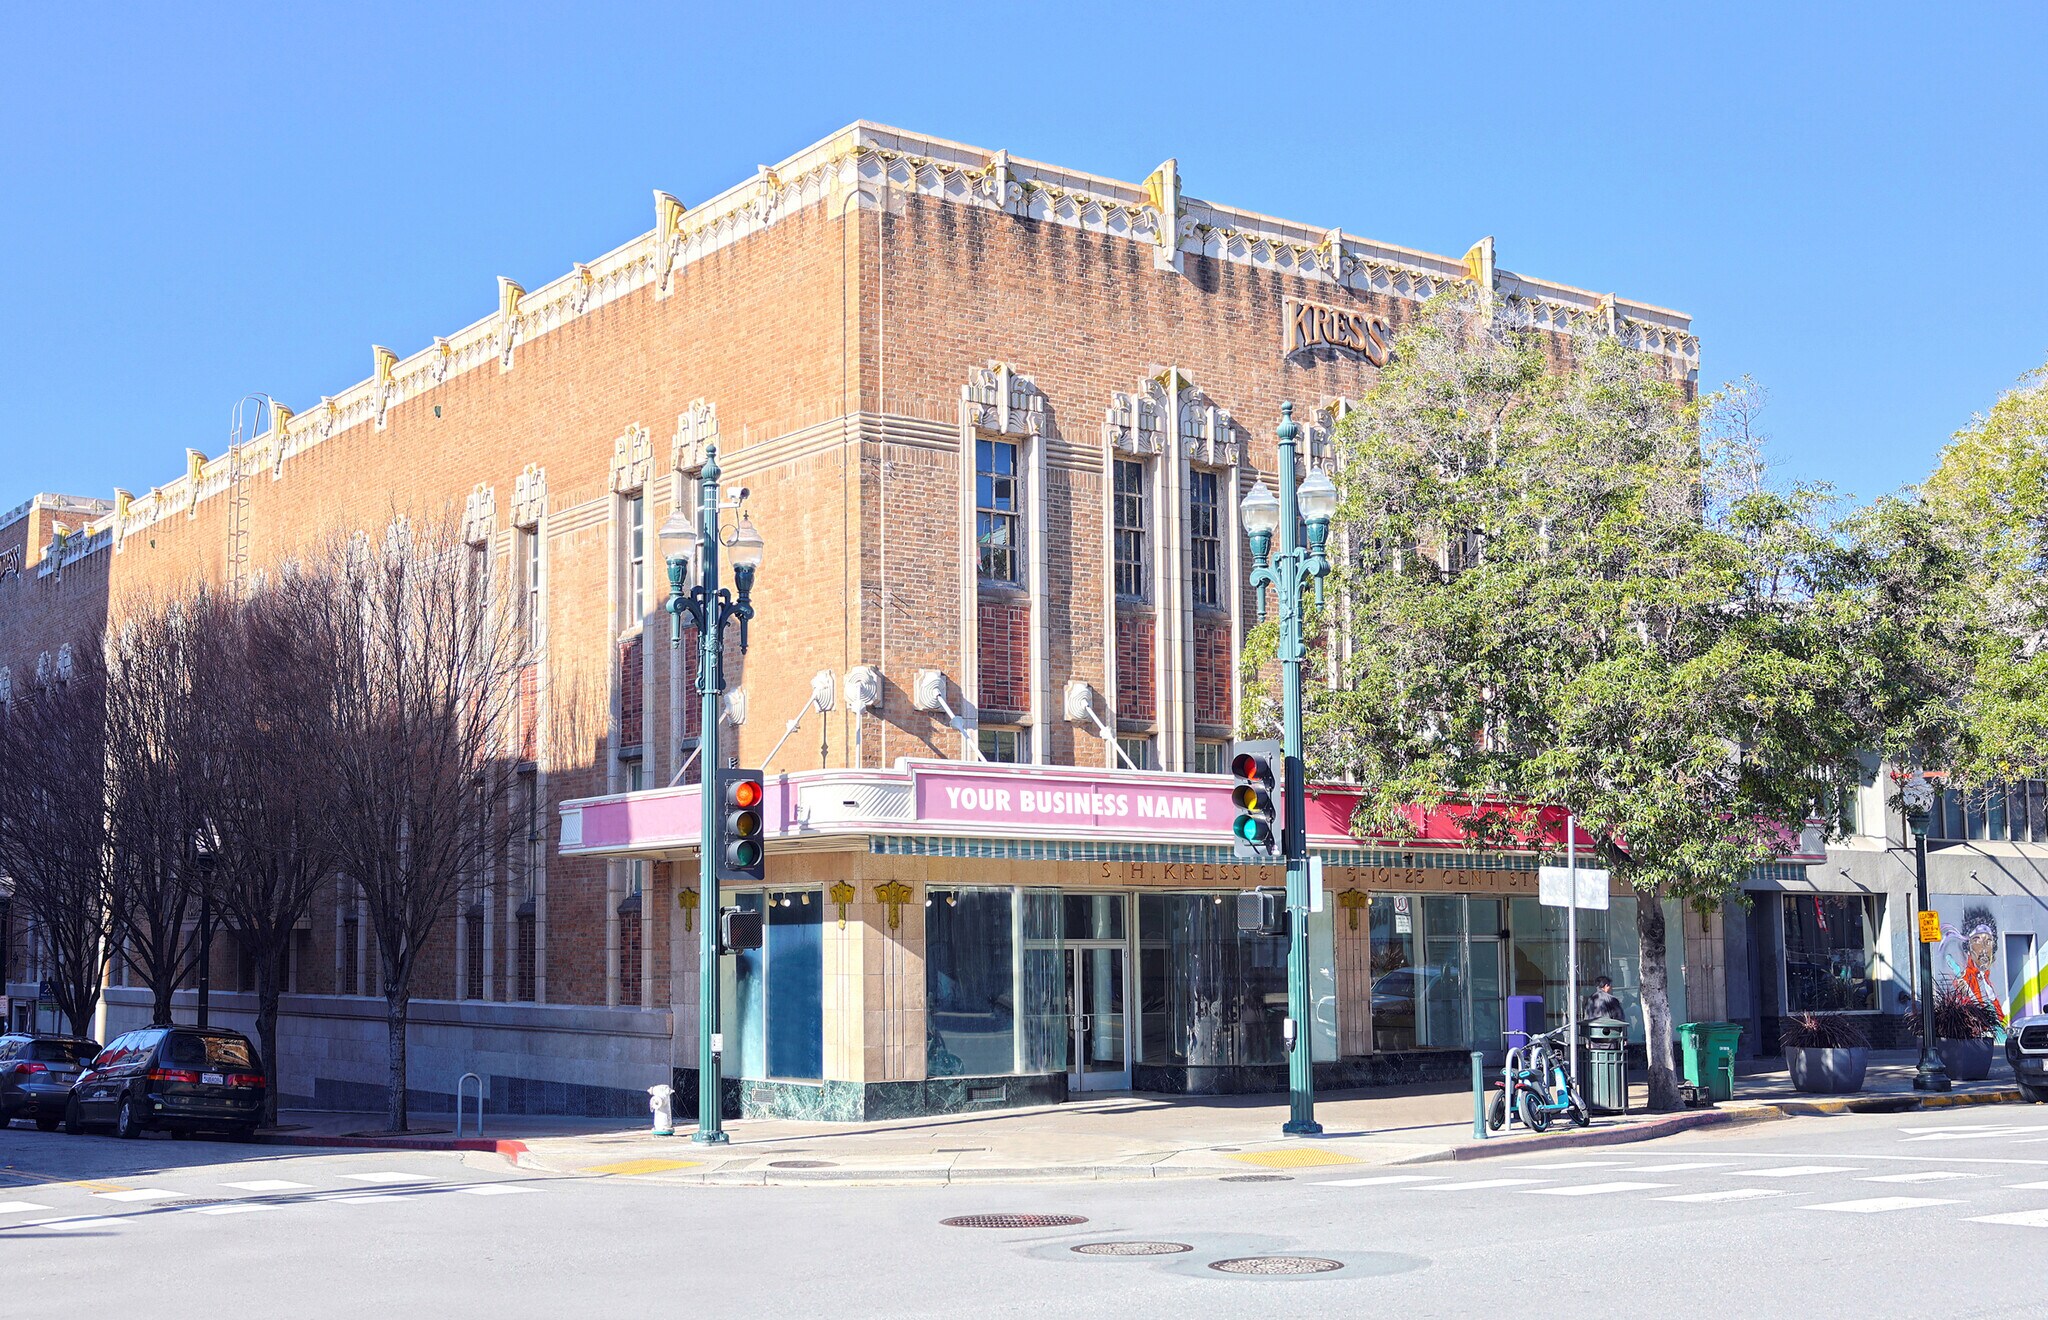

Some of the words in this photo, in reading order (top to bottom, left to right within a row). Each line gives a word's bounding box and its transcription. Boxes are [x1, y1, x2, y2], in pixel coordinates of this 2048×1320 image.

[1286, 300, 1389, 367] KRESS
[945, 787, 1011, 811] YOUR
[1020, 789, 1128, 817] BUSINESS
[1137, 796, 1207, 820] NAME
[1259, 866, 1272, 881] &
[1346, 867, 1425, 884] 5-10-25
[1442, 870, 1496, 886] CENT
